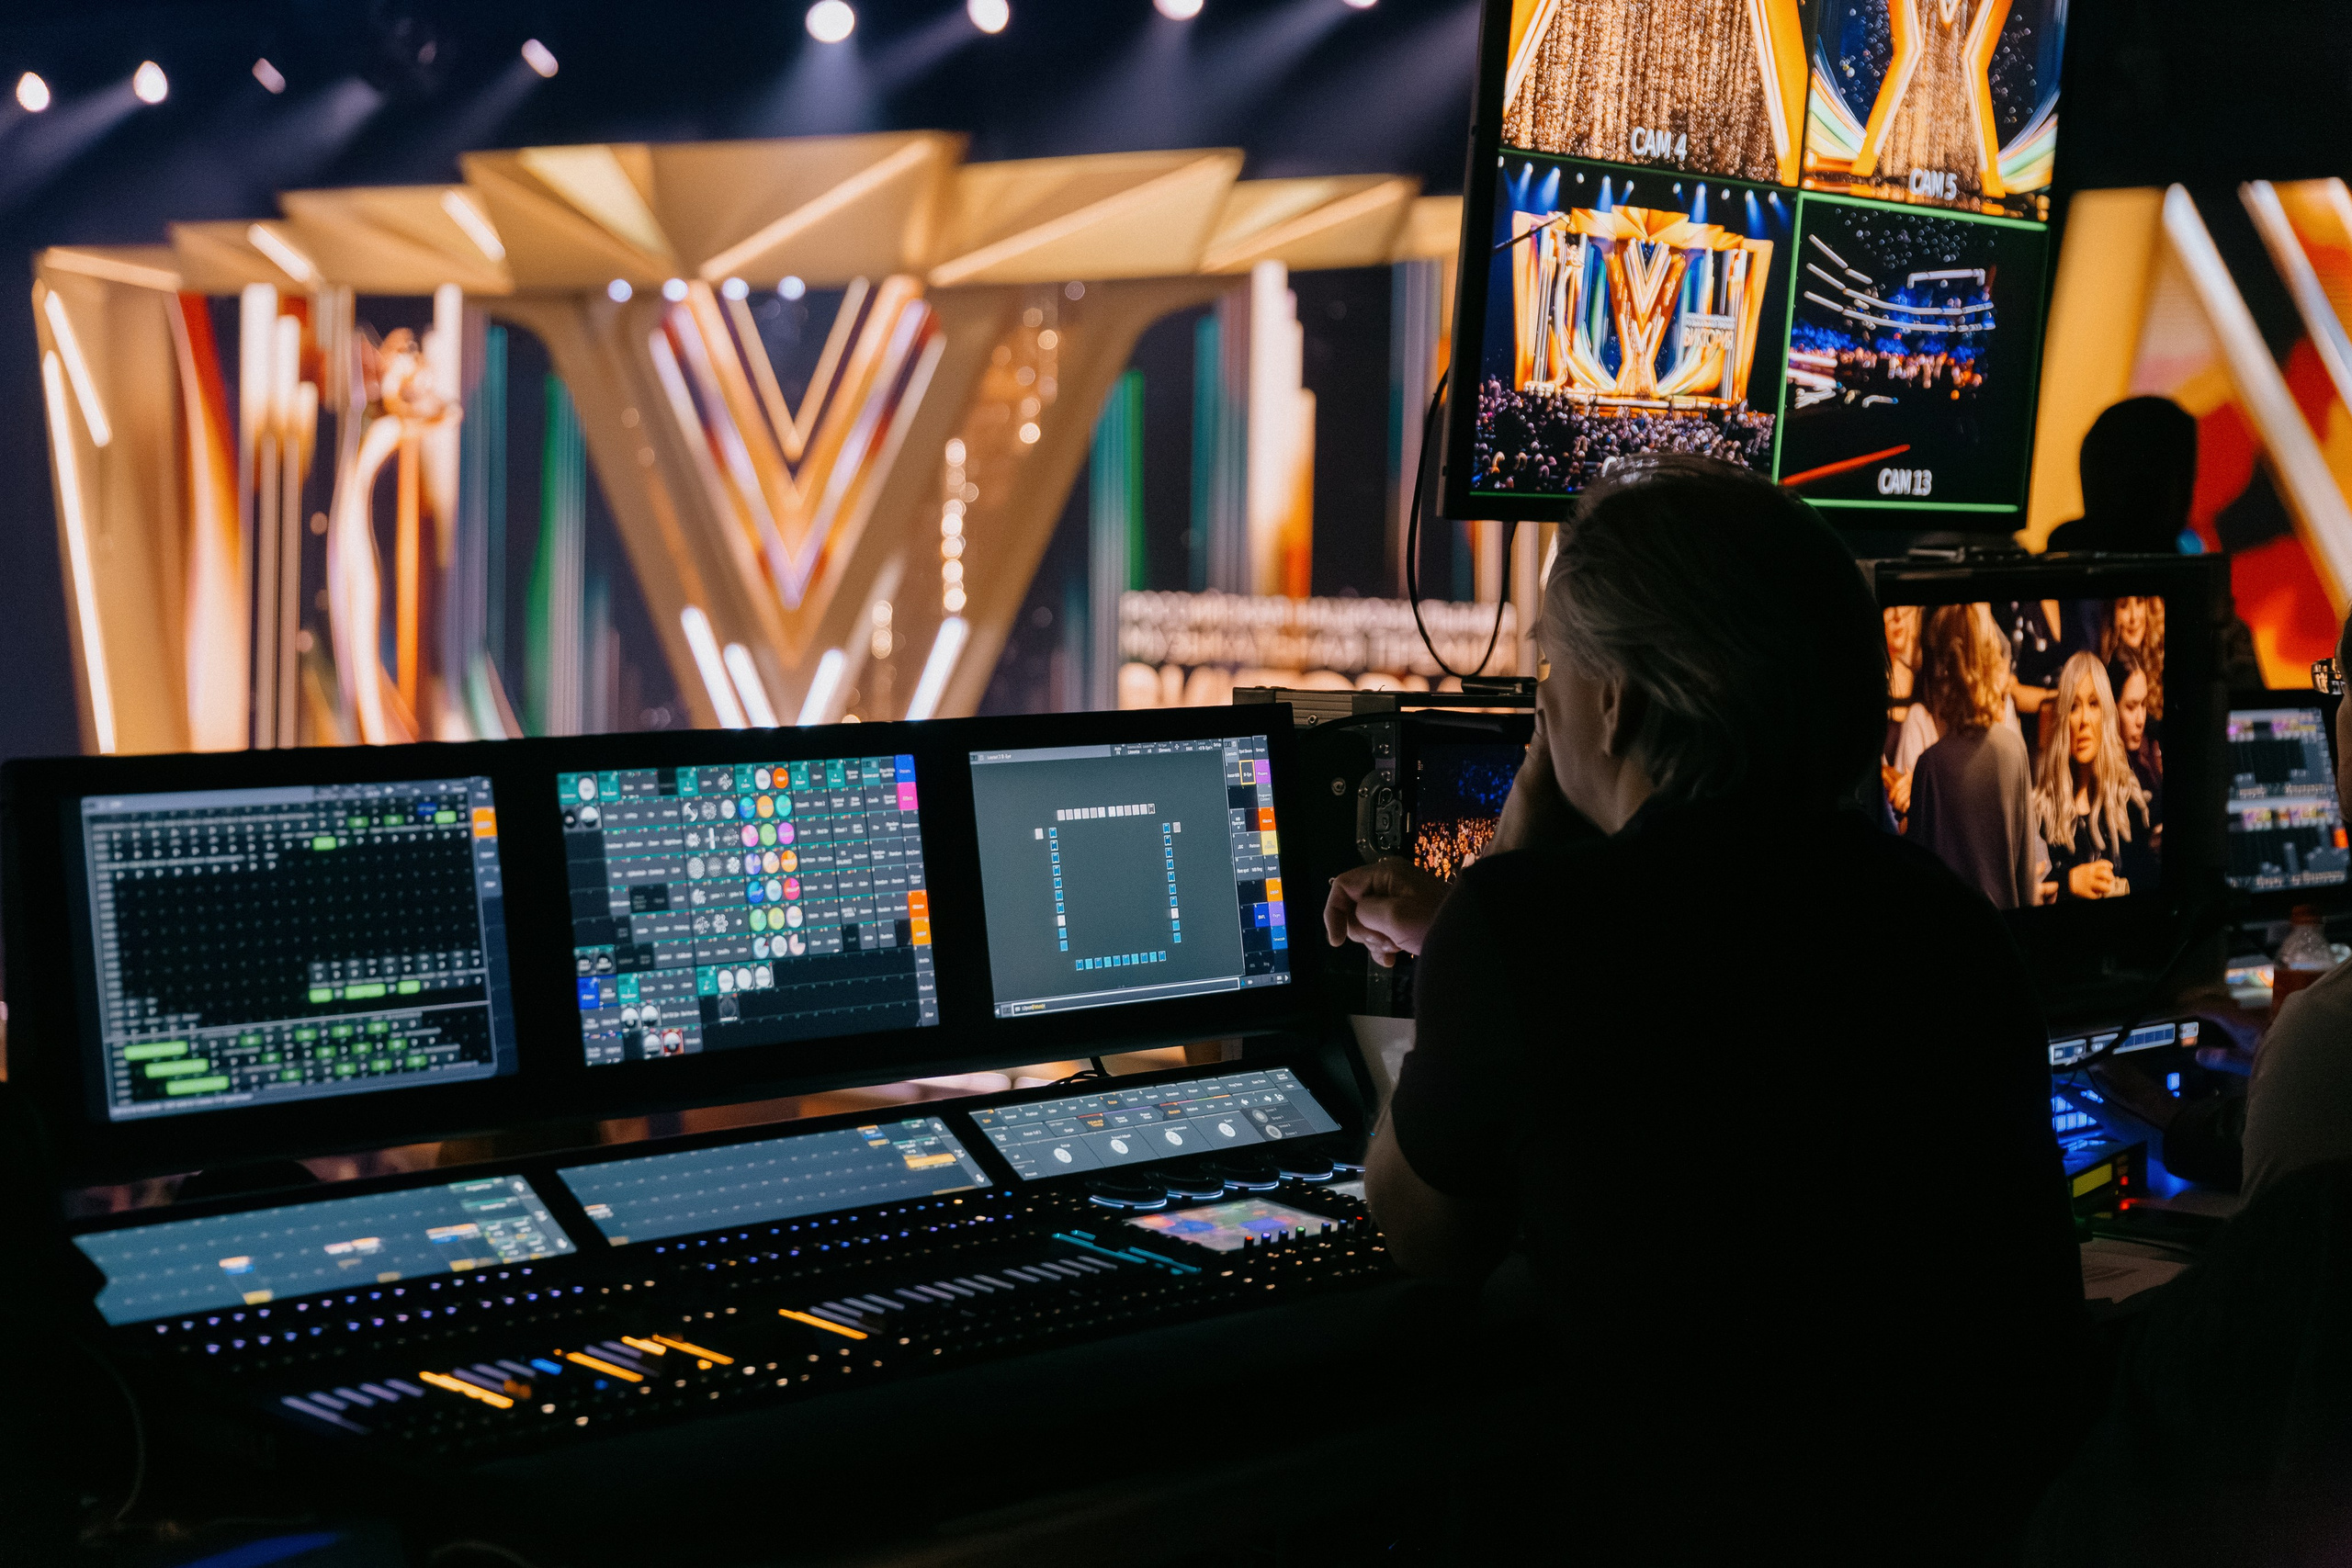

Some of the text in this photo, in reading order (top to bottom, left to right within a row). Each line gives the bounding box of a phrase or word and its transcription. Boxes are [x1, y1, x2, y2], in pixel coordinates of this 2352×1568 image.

[1631, 127, 1687, 162] CAM 4
[1909, 168, 1957, 200] CAM 5
[1878, 468, 1932, 496] CAM 13
